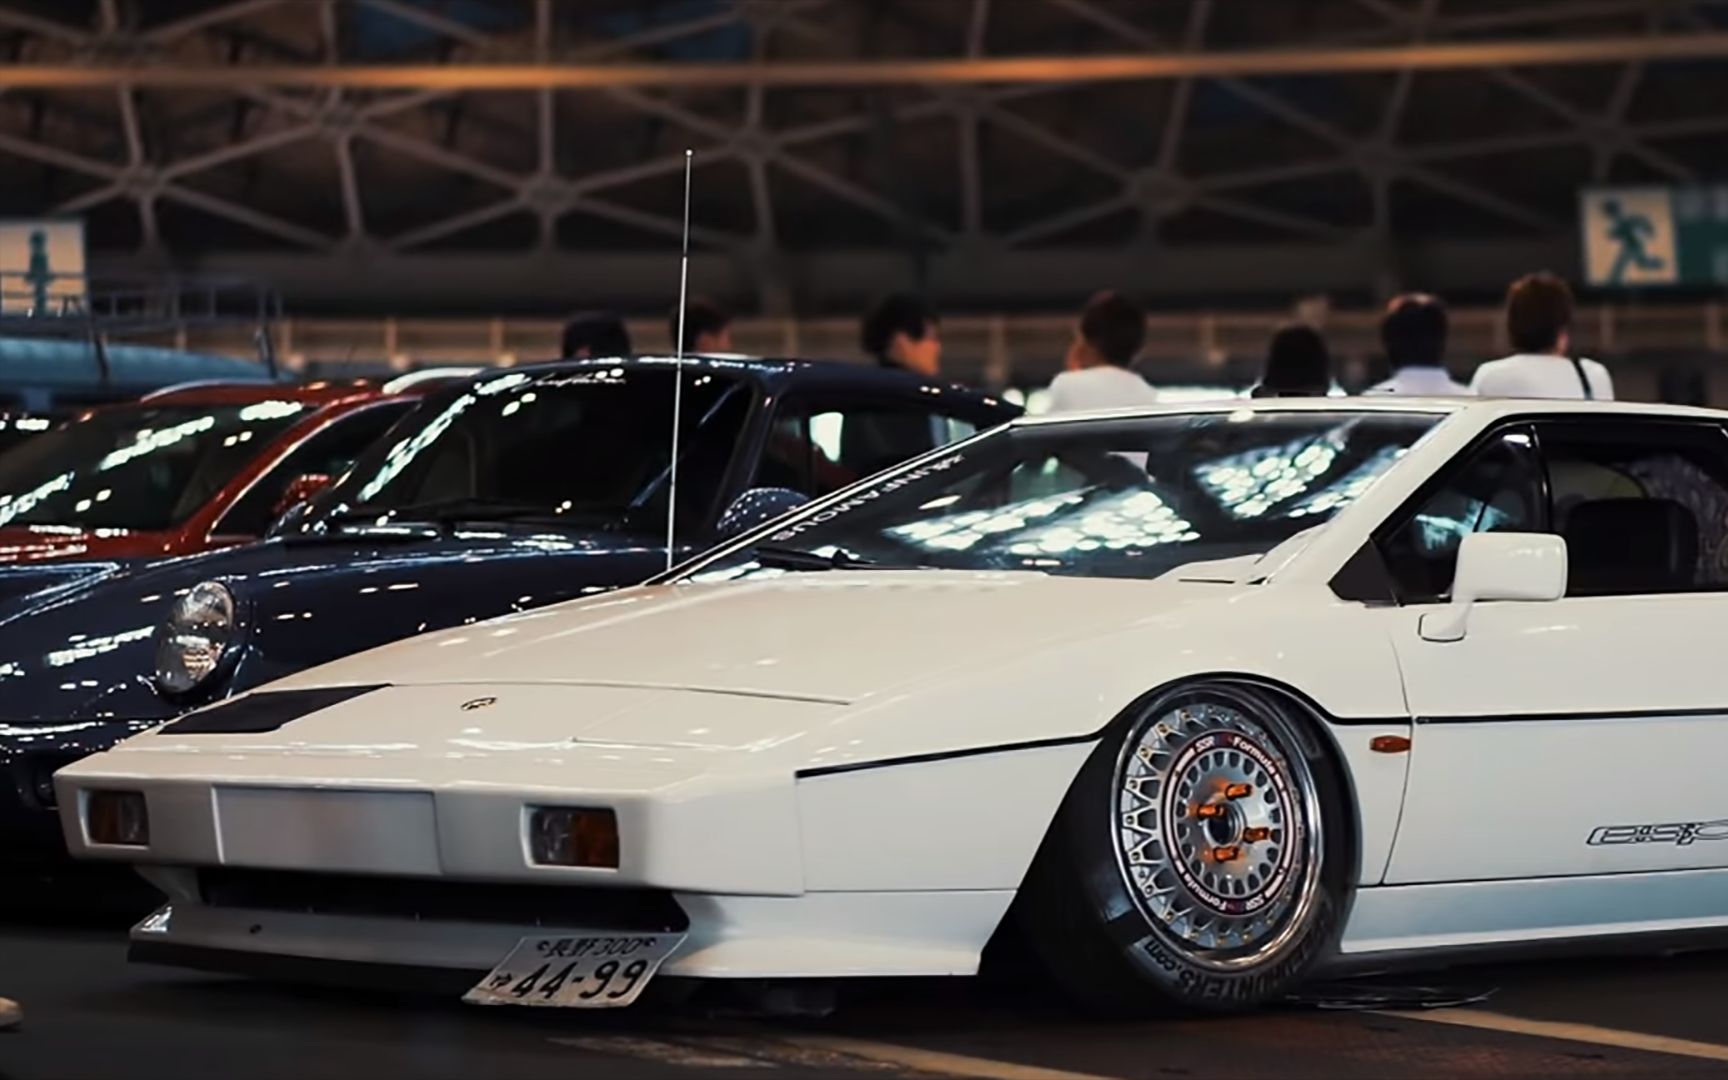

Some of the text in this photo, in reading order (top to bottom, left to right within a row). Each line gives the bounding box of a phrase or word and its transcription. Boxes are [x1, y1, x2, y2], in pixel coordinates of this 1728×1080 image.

[1233, 737, 1276, 774] Formula
[1183, 873, 1227, 911] Formula
[511, 959, 649, 999] 44-99
